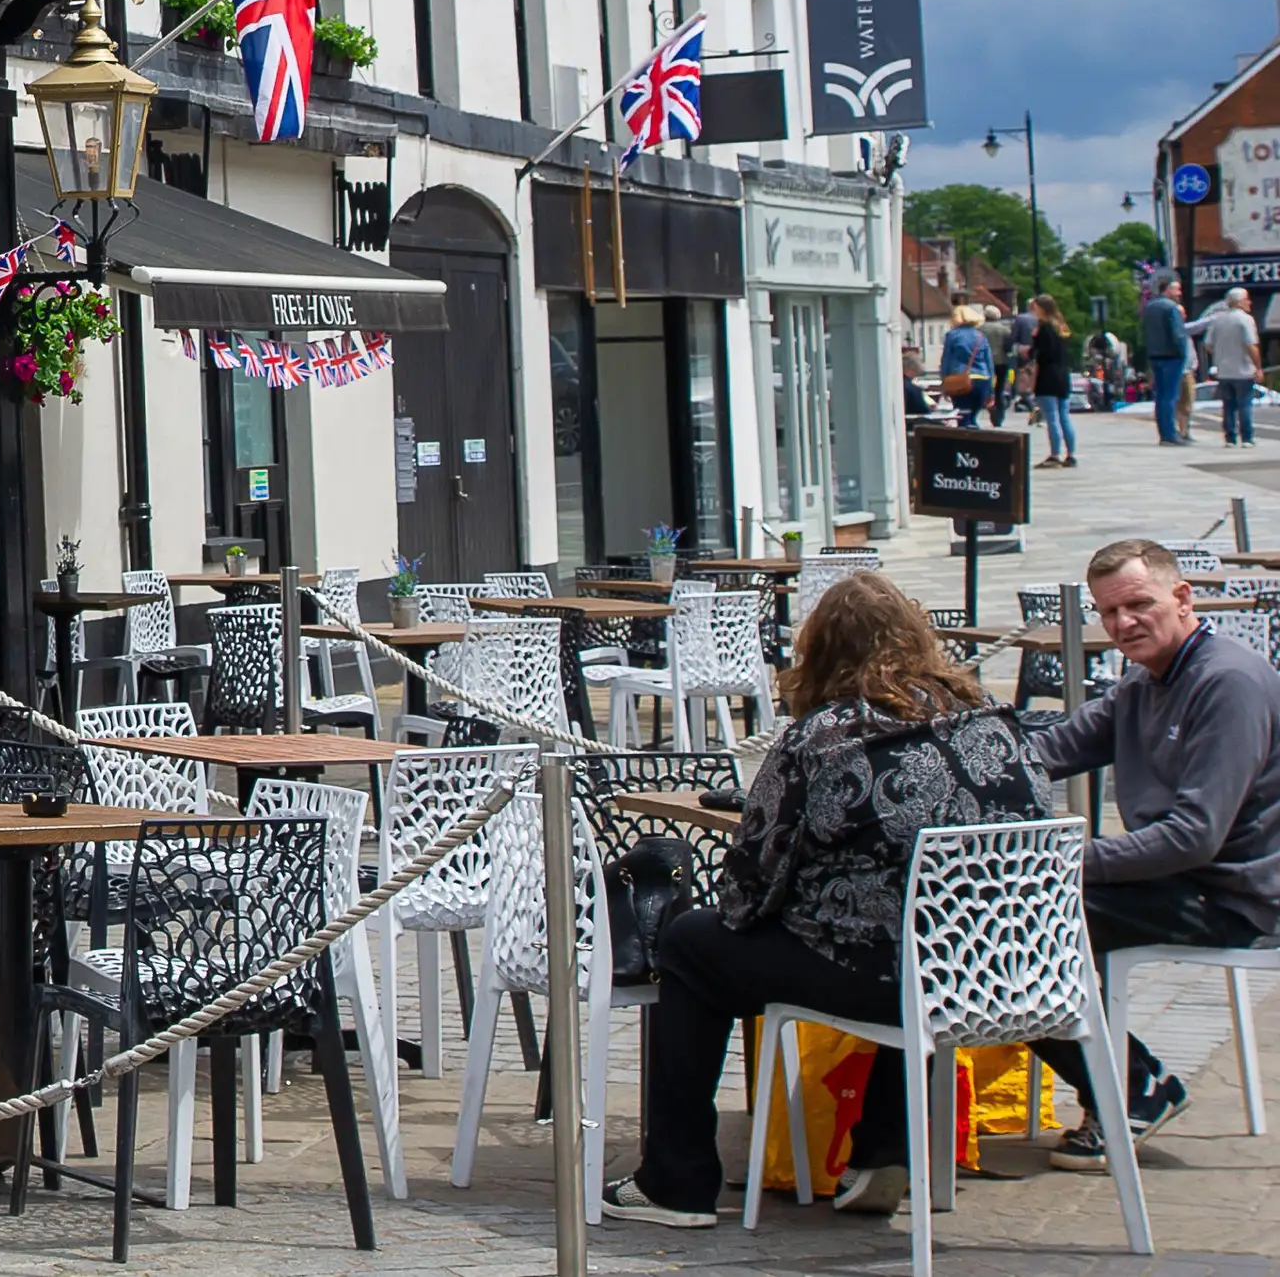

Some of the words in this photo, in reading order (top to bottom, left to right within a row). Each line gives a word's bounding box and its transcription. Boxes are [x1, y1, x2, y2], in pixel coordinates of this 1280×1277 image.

[272, 294, 304, 325] FREE
[306, 295, 356, 325] HOUSE
[956, 452, 979, 468] No
[933, 473, 1001, 499] Smoking
